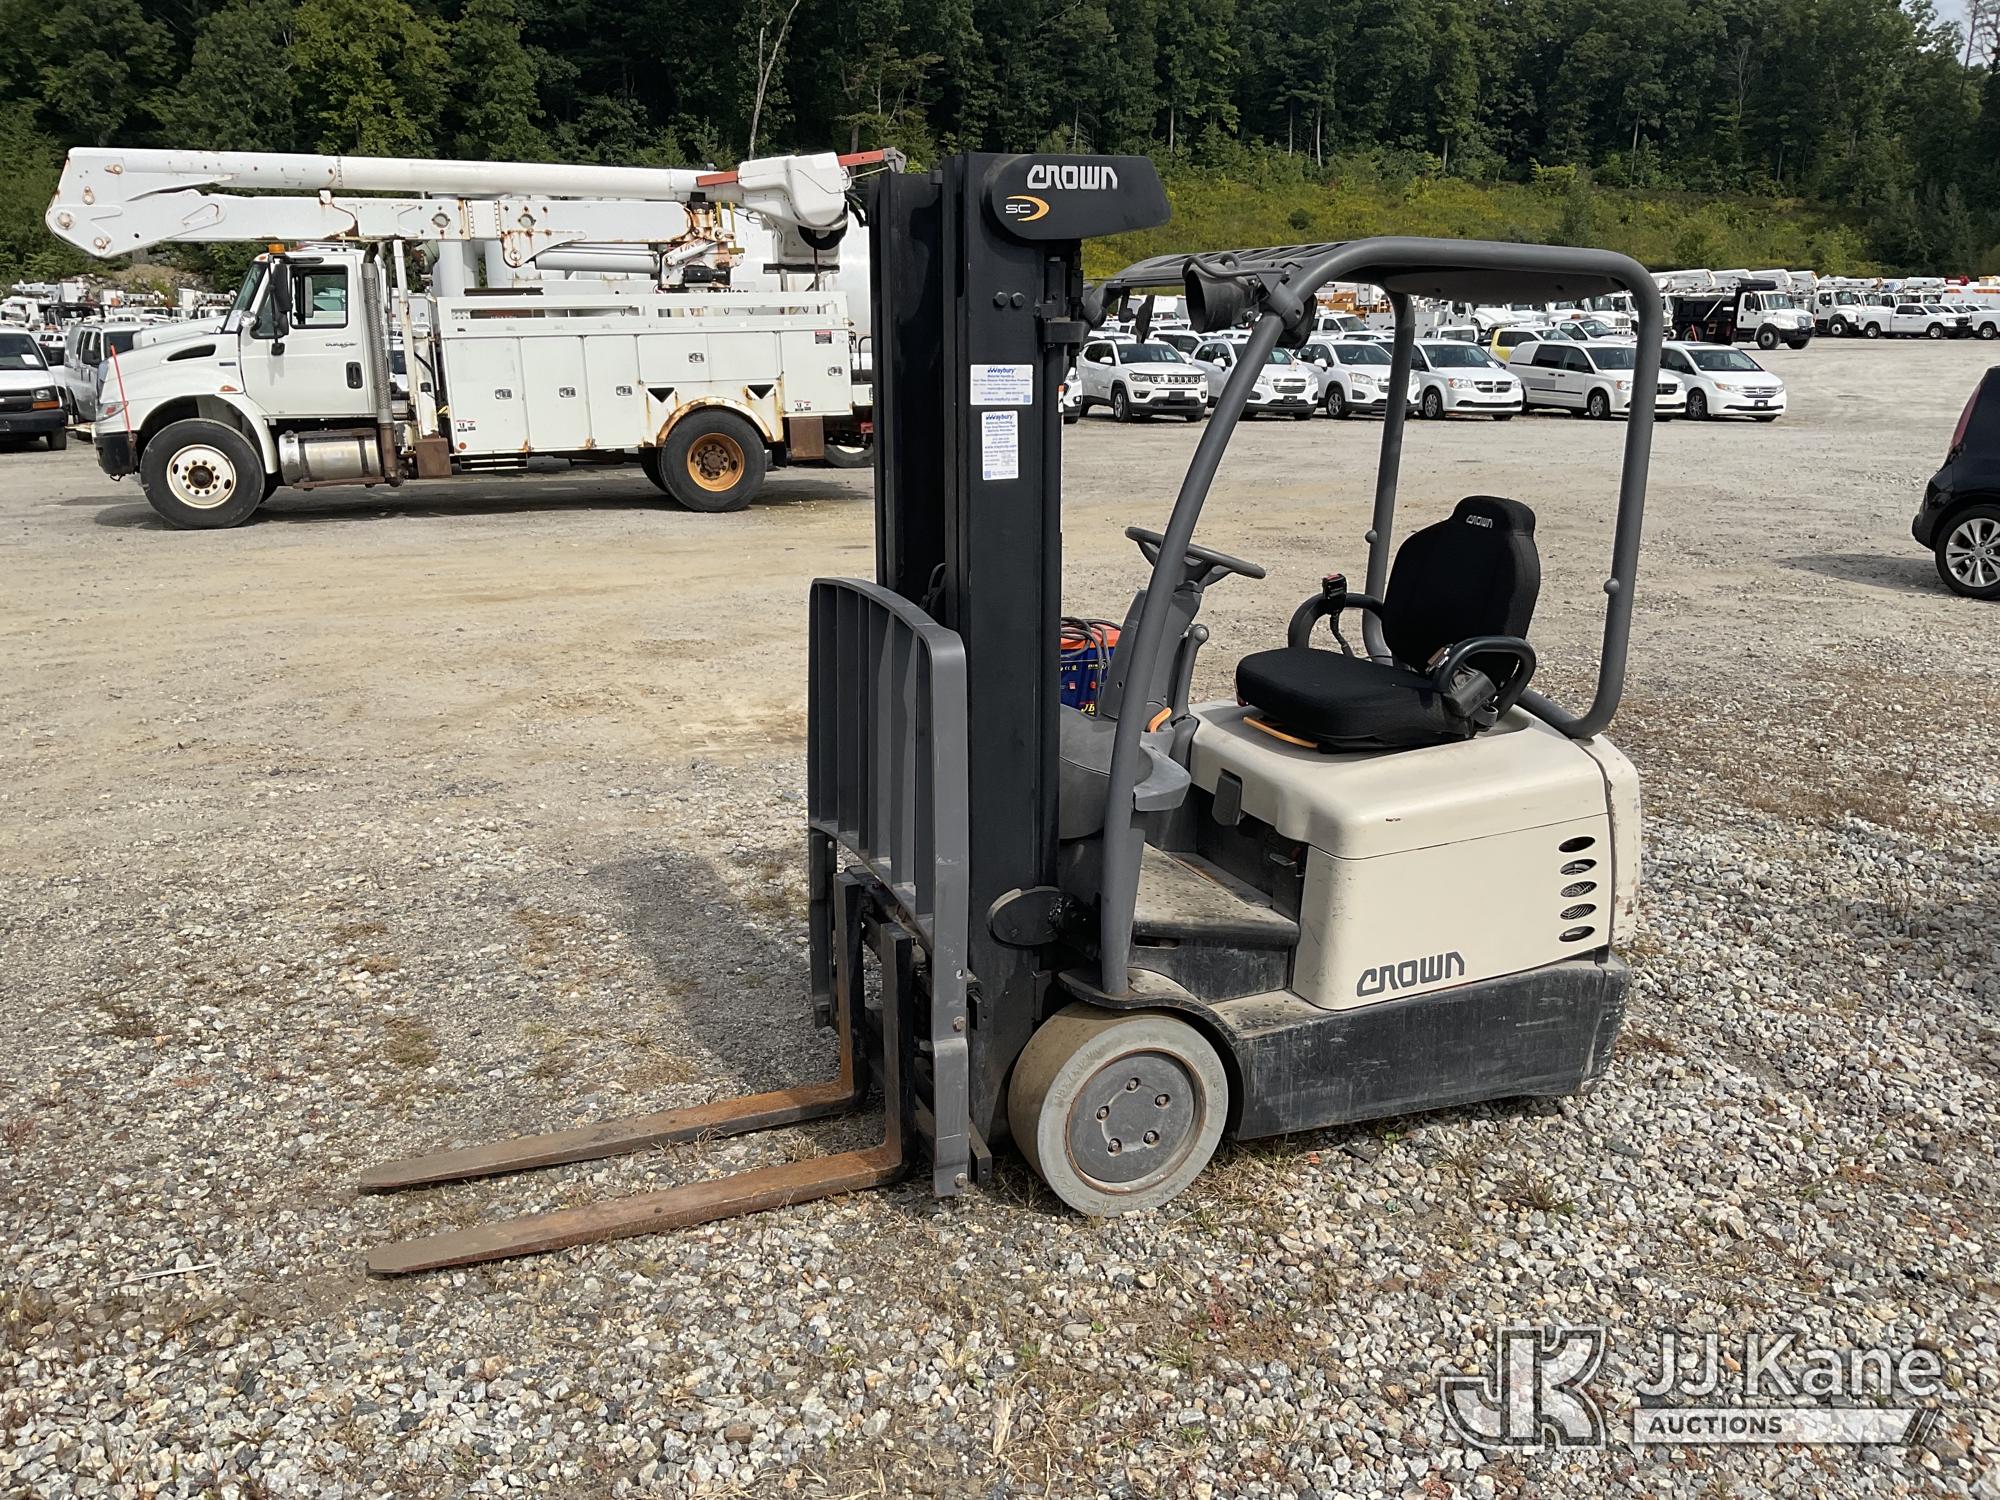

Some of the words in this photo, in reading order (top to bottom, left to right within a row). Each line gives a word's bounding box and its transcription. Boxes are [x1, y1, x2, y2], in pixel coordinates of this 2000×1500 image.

[1026, 164, 1118, 190] CROWN
[1005, 203, 1031, 214] SC
[1356, 951, 1465, 997] CROWN
